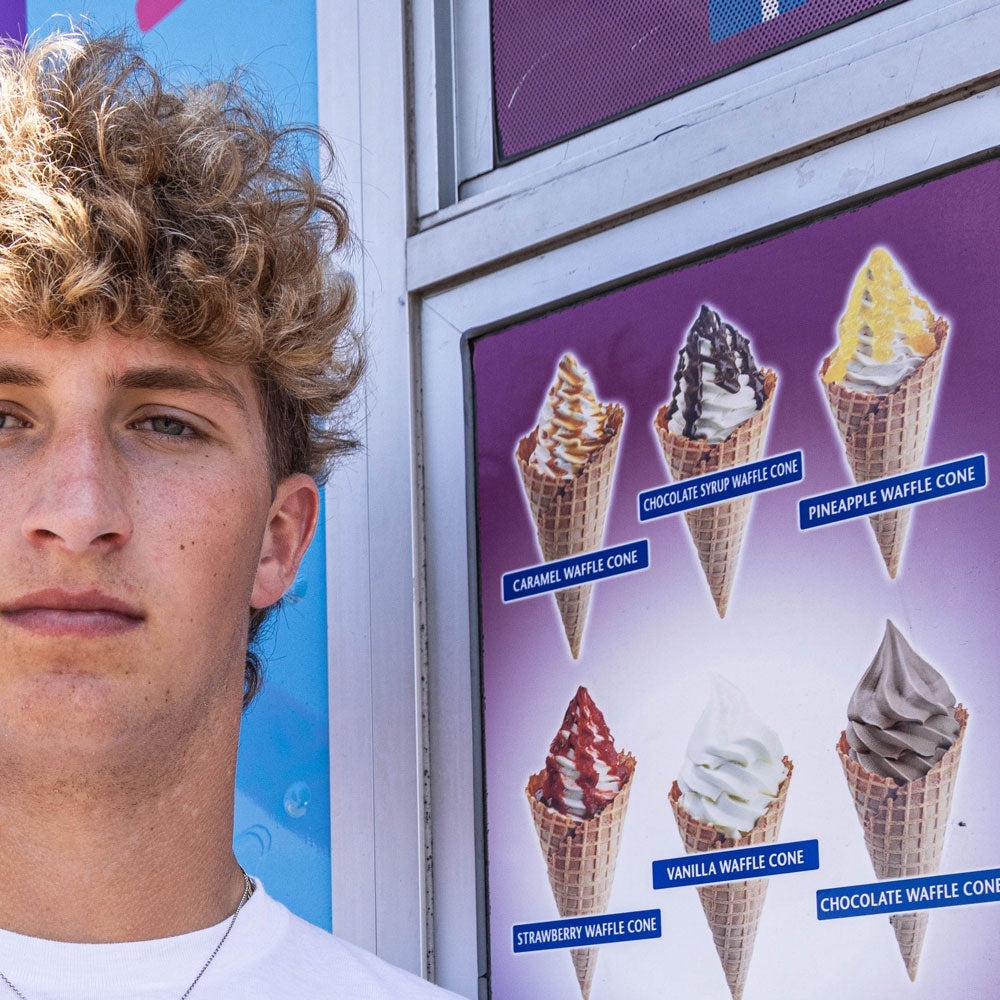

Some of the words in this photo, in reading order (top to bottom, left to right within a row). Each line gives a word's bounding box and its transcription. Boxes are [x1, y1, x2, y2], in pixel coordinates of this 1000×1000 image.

[643, 485, 699, 512] CHOCOLATE
[700, 477, 731, 497] SYRUP
[731, 466, 769, 489] WAFFLE
[770, 458, 799, 479] CONE
[808, 490, 878, 521] PINEAPPLE
[880, 476, 933, 503] WAFFLE
[935, 466, 976, 489] CONE
[512, 569, 562, 592] CARAMEL
[563, 558, 604, 580] WAFFLE
[606, 550, 638, 569] CONE
[666, 861, 717, 881] VANILLA
[719, 854, 766, 874] WAFFLE
[768, 849, 805, 868] CONE
[820, 889, 903, 912] CHOCOLATE
[905, 882, 960, 903] WAFFLE
[963, 877, 1000, 897] CONE
[517, 925, 583, 946] STRAWBERRY
[584, 920, 625, 938] WAFFLE
[627, 917, 657, 934] CONE
